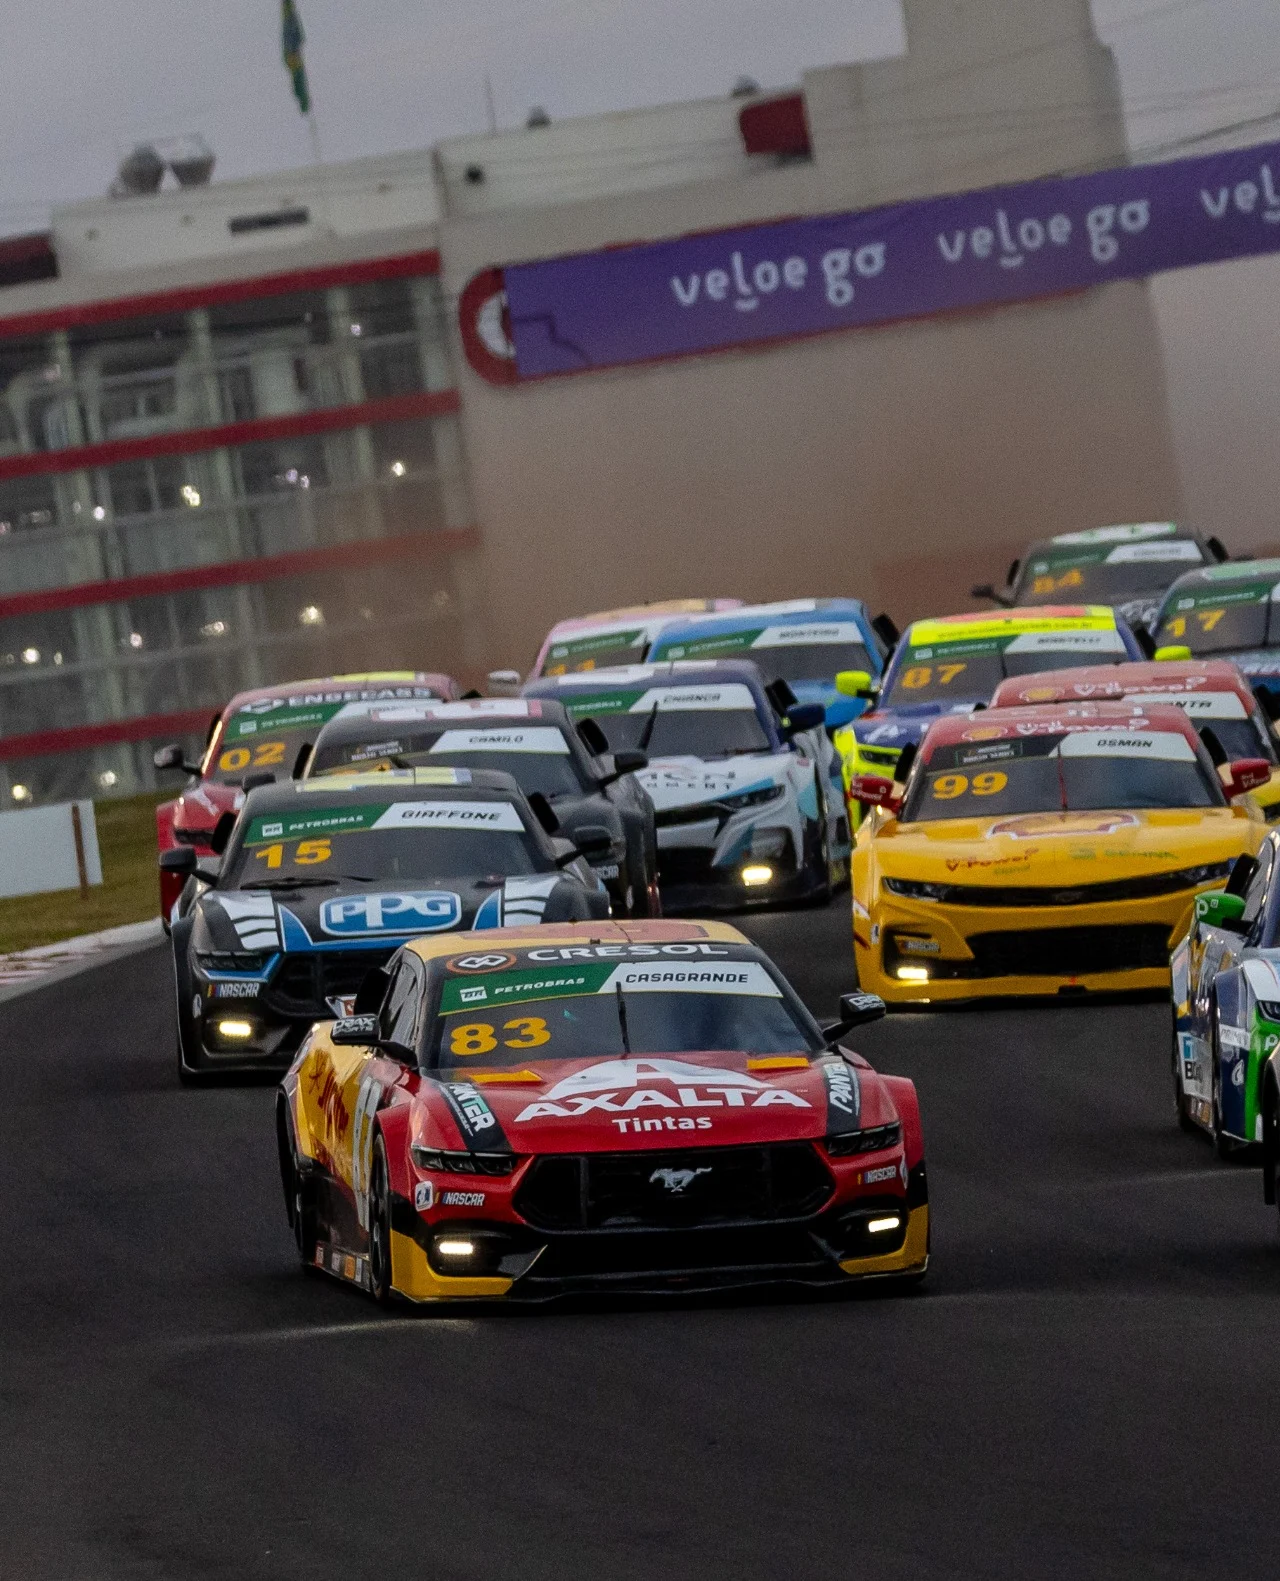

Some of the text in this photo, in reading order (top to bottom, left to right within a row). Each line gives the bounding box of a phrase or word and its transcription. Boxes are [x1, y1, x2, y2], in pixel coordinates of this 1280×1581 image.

[937, 200, 1149, 267] veloe go
[673, 242, 886, 310] veloe go
[1165, 609, 1225, 637] 17
[219, 742, 286, 772] 02
[932, 771, 1008, 800] 99
[289, 815, 364, 831] PETROBRAS
[402, 811, 501, 823] GIAFFONE
[256, 839, 332, 869] 15
[330, 895, 452, 929] PPG
[527, 943, 728, 961] CRESOL
[218, 982, 260, 998] NASCAR
[494, 978, 585, 994] PETROBRAS
[625, 973, 748, 984] CASAGRANDE
[450, 1017, 551, 1055] 83
[513, 1087, 812, 1123] AXALTA
[612, 1115, 713, 1133] Tintas
[442, 1192, 485, 1207] NASCAR
